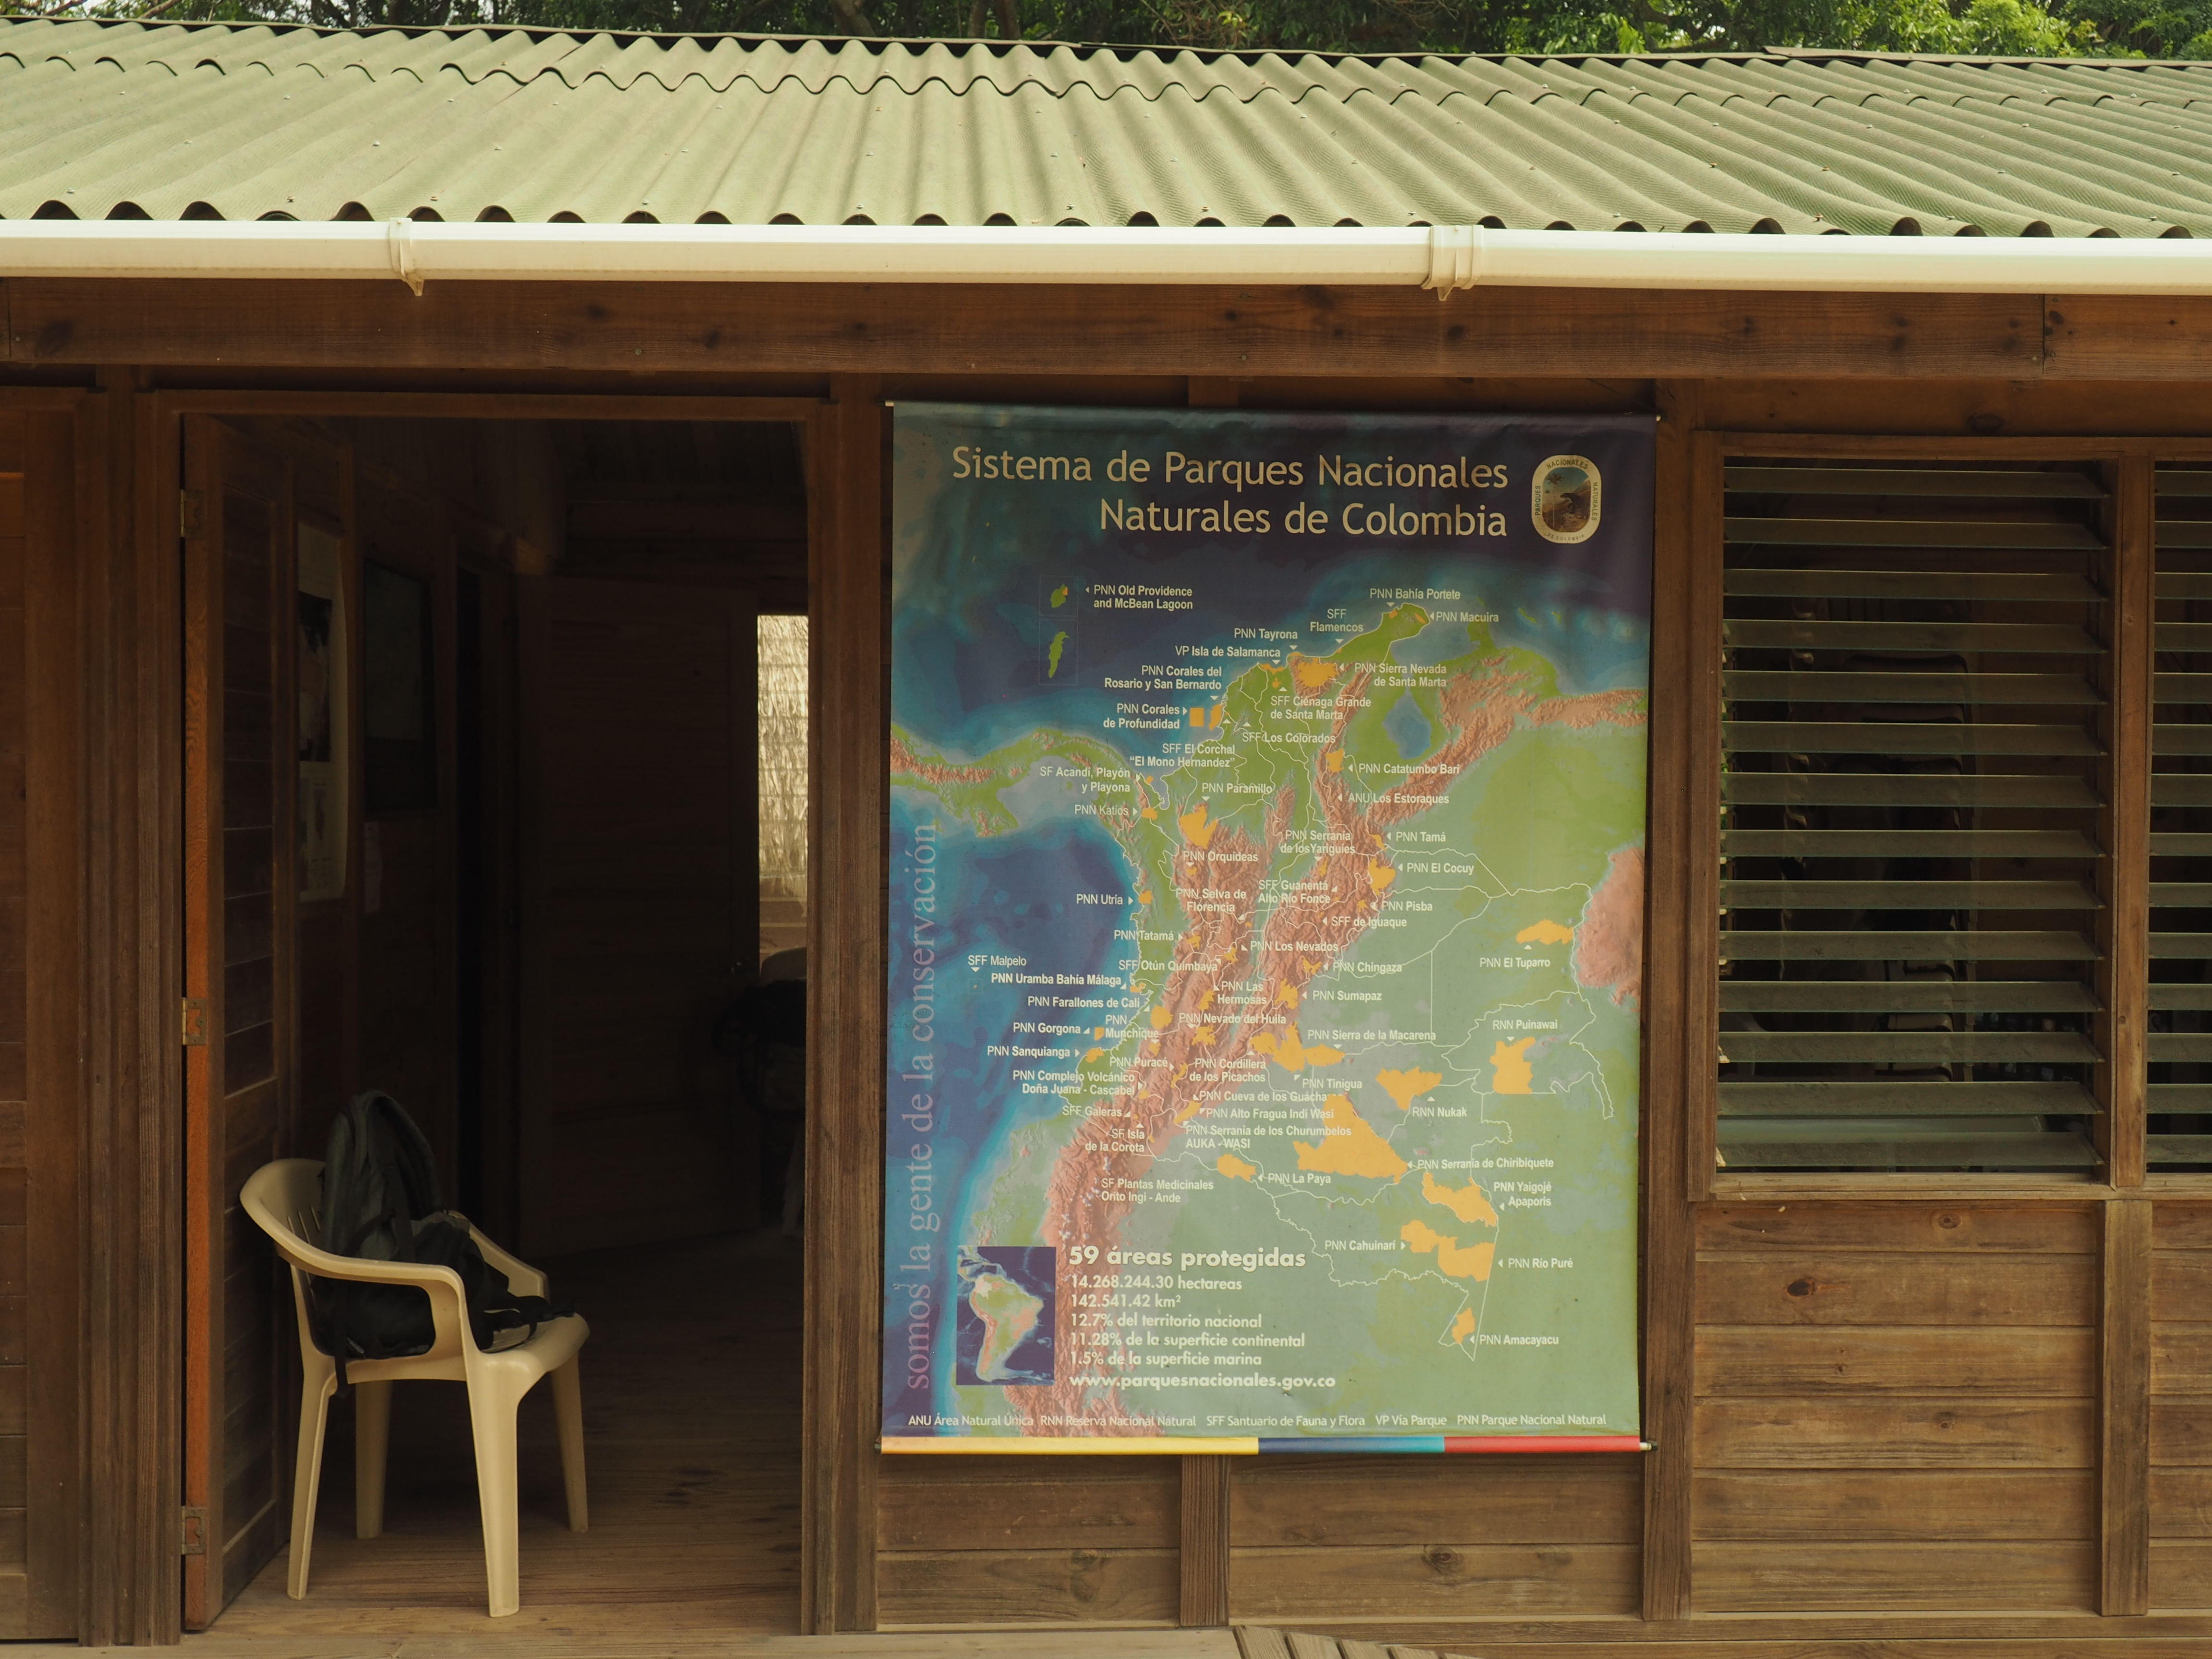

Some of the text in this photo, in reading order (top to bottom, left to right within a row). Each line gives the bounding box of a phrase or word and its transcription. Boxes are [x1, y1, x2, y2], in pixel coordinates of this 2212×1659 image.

[952, 446, 1508, 493] Sistema de Parques Nacionales
[1547, 459, 1588, 469] NACIONALES
[1101, 498, 1507, 536] Naturales de Colombia
[1094, 585, 1192, 596] PNN Old Providence
[1370, 588, 1460, 600] PNN Bahía Portete
[1094, 599, 1193, 612] and McBean Lagoon
[1327, 609, 1346, 619] SFF
[1310, 622, 1363, 632] Flamencos
[1234, 628, 1298, 642] PNN Tayrona
[1176, 646, 1280, 657] VP Isla de Salamanca
[1142, 665, 1221, 676] PNN Corales del
[1355, 663, 1446, 673] PNN Sierra Nevada
[1105, 678, 1221, 691] Rosario y San Bernardo
[1374, 677, 1446, 687] de Santa Marta
[1117, 704, 1179, 714] PNN Corales
[1104, 718, 1179, 729] de Profundidad
[1040, 767, 1130, 780] SF Acandí, Playón
[1082, 782, 1130, 793] y Playona
[1396, 831, 1445, 842] PNN Tamá
[1183, 852, 1258, 863] PNN Orquídeas
[1407, 864, 1474, 875] PNN El Cocuy
[1077, 894, 1123, 904] PNN Utría
[1250, 941, 1338, 951] PNN Los Nevados
[968, 955, 1026, 967] SFF Malpelo
[1480, 958, 1550, 969] PNN El Tuparro
[991, 973, 1121, 987] PNN Uramba Bahía Málaga
[1313, 991, 1382, 1002] PNN Sumapaz
[1028, 997, 1139, 1008] PNN Farallones de Cali
[1493, 1020, 1557, 1030] RNN Puinawai
[1308, 1030, 1436, 1040] PNN Sierra de la Macarena
[987, 1046, 1070, 1058] PNN Sanquianga
[1303, 1079, 1362, 1091] PNN Tinigua
[900, 825, 940, 1388] somos la gente de la conservación
[1412, 1107, 1467, 1117] RNN Nukak
[1494, 1182, 1551, 1194] PNN Yaigojé
[1508, 1197, 1551, 1209] Apaporis
[1325, 1240, 1395, 1250] PNN Cahuinarí
[1070, 1245, 1306, 1272] 59 áreas protegidas
[1508, 1258, 1573, 1268] PNN Río Puré
[1071, 1275, 1242, 1290] 14.268.244.30 hectareas
[1071, 1294, 1150, 1308] 142.541.42
[1071, 1312, 1262, 1328] 12.7% del territorio nacional
[1071, 1332, 1305, 1349] 11.28% de la superficie continental
[1480, 1335, 1559, 1347] PNN Amacayacu
[1071, 1351, 1262, 1368] 1.5% de la superficie marina
[1070, 1372, 1335, 1390] www.parquesnacionales.gov.co
[908, 1412, 1606, 1428] ANU Área Natural Única RNN Reserva Nacional Natural SFF Santuario de Fauna y Flora VP Vía Parque PNN Parque Nacional Natural
